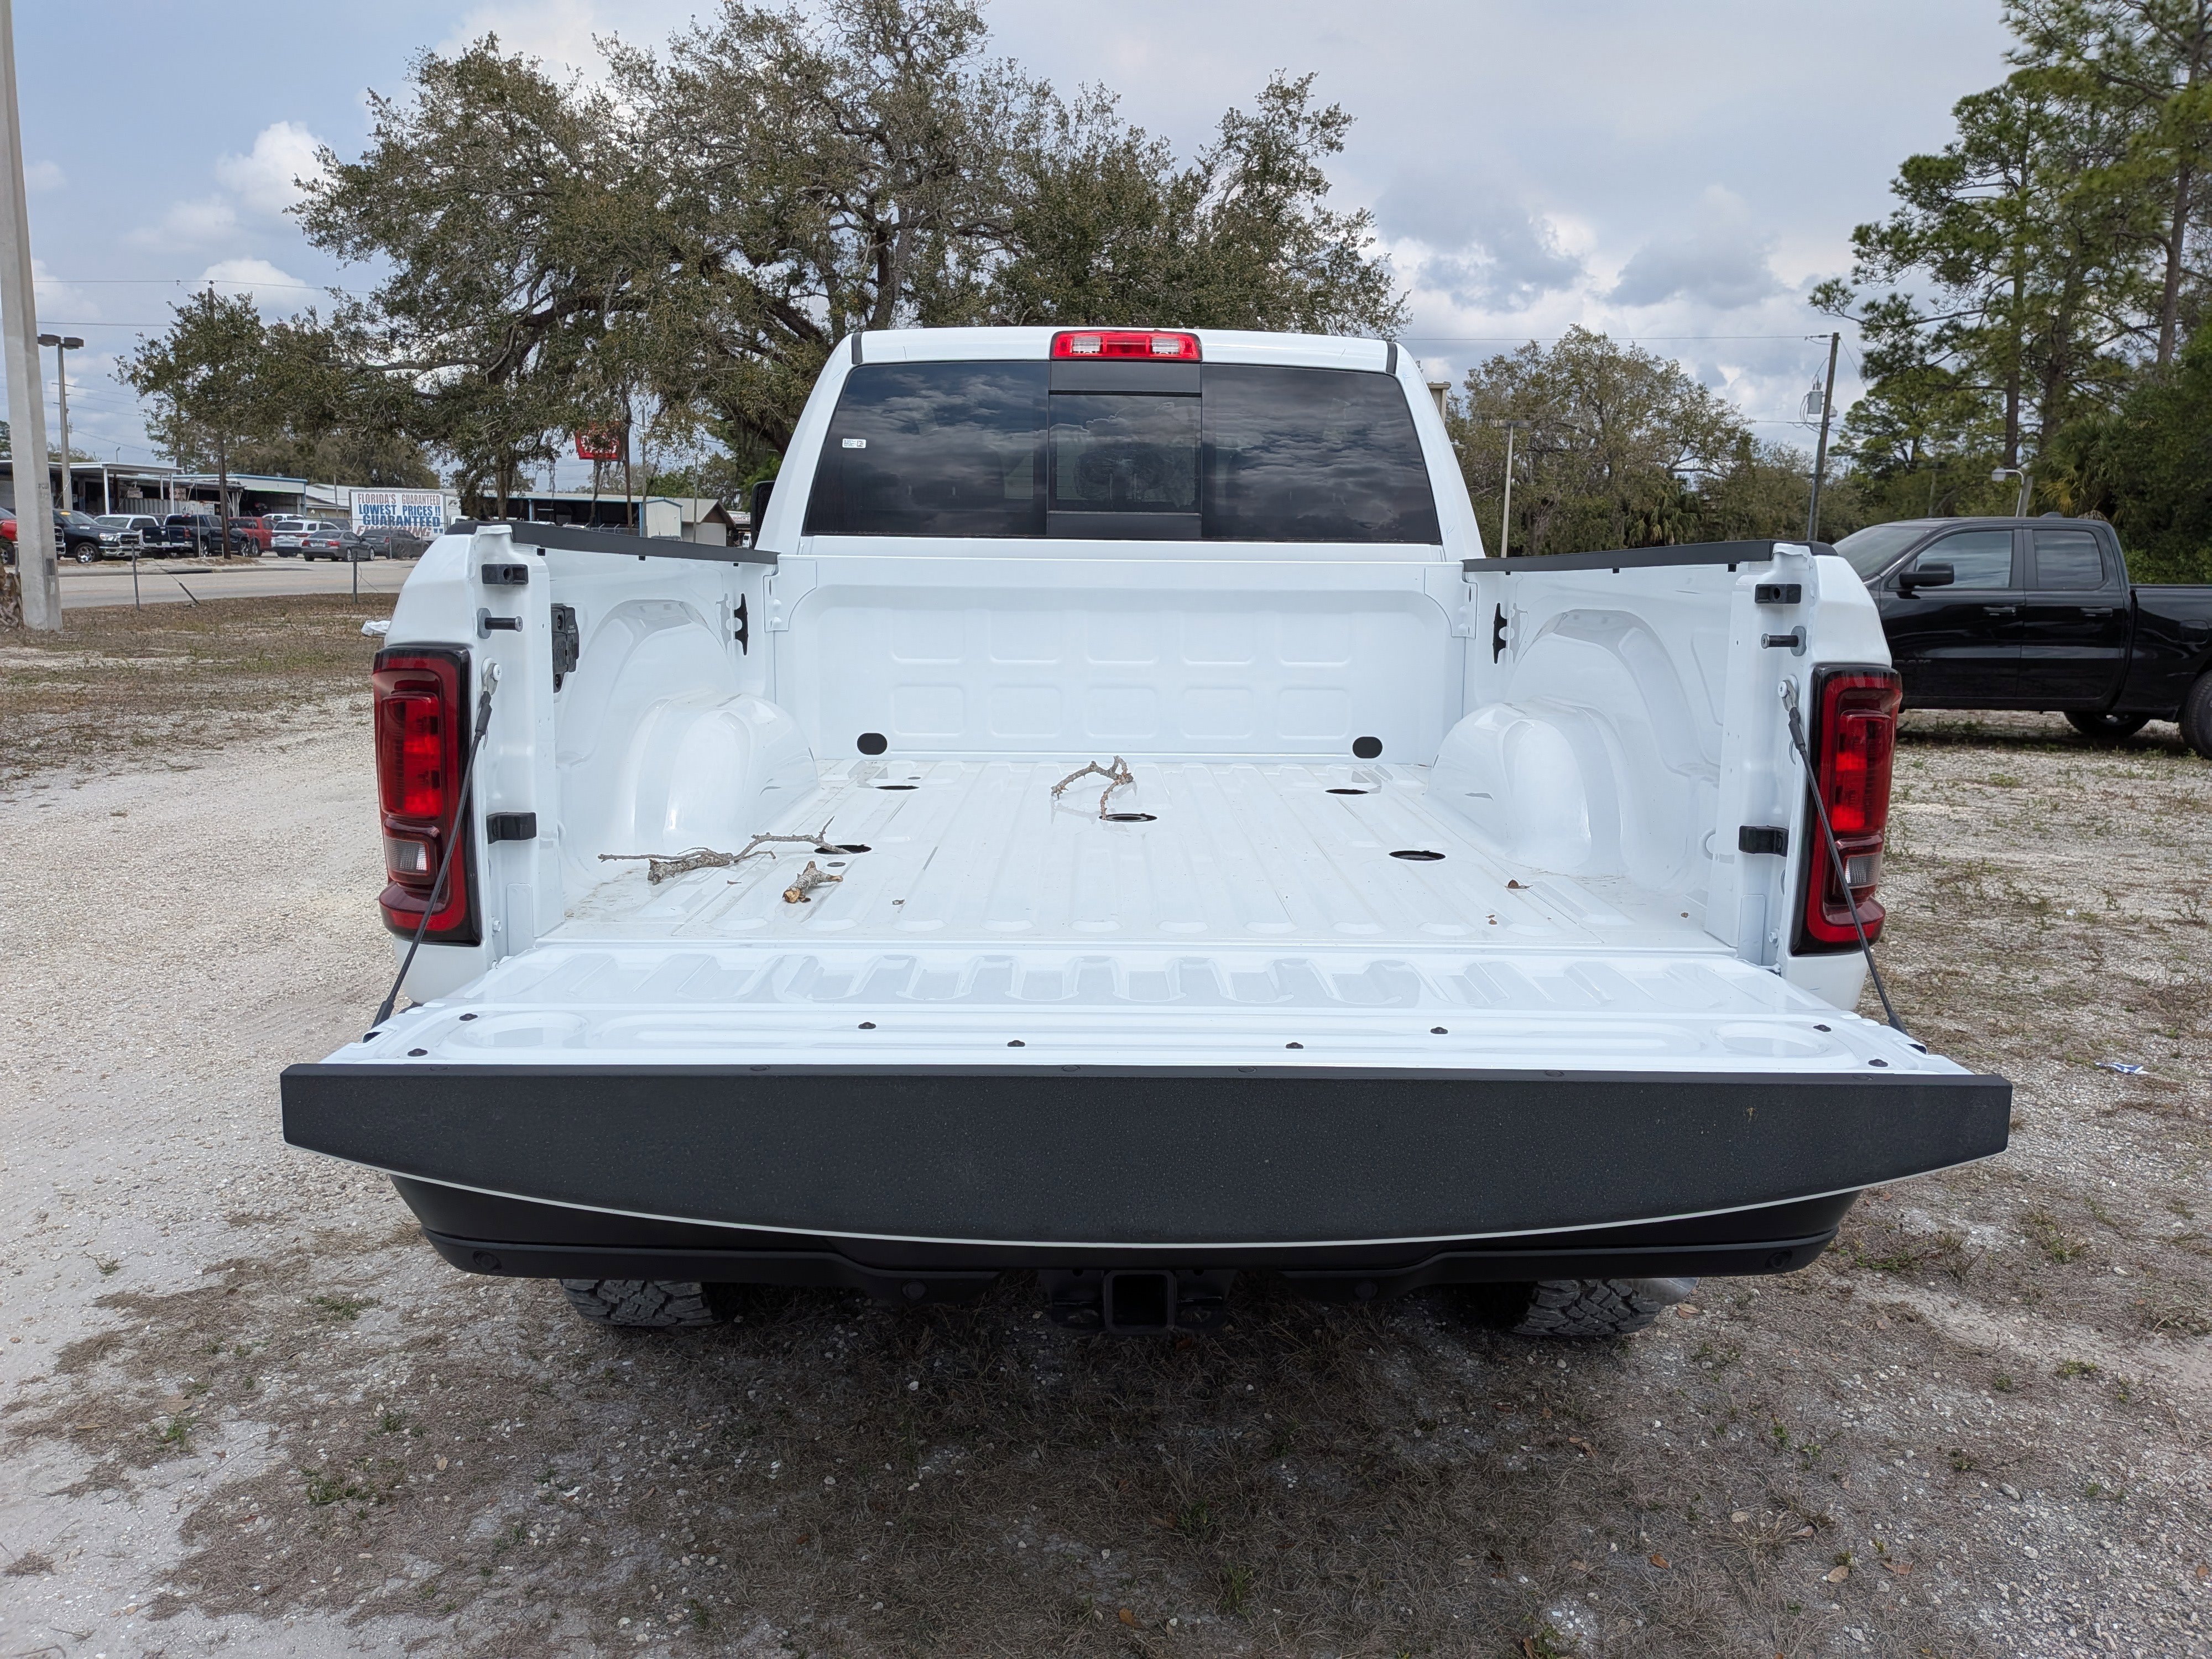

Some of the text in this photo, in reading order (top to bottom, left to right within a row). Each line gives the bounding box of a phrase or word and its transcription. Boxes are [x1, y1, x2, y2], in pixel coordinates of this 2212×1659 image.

[358, 493, 440, 505] FLORIDA'S GUARANTEED
[359, 504, 397, 515] LOWEST
[363, 515, 440, 526] GUARANTEED
